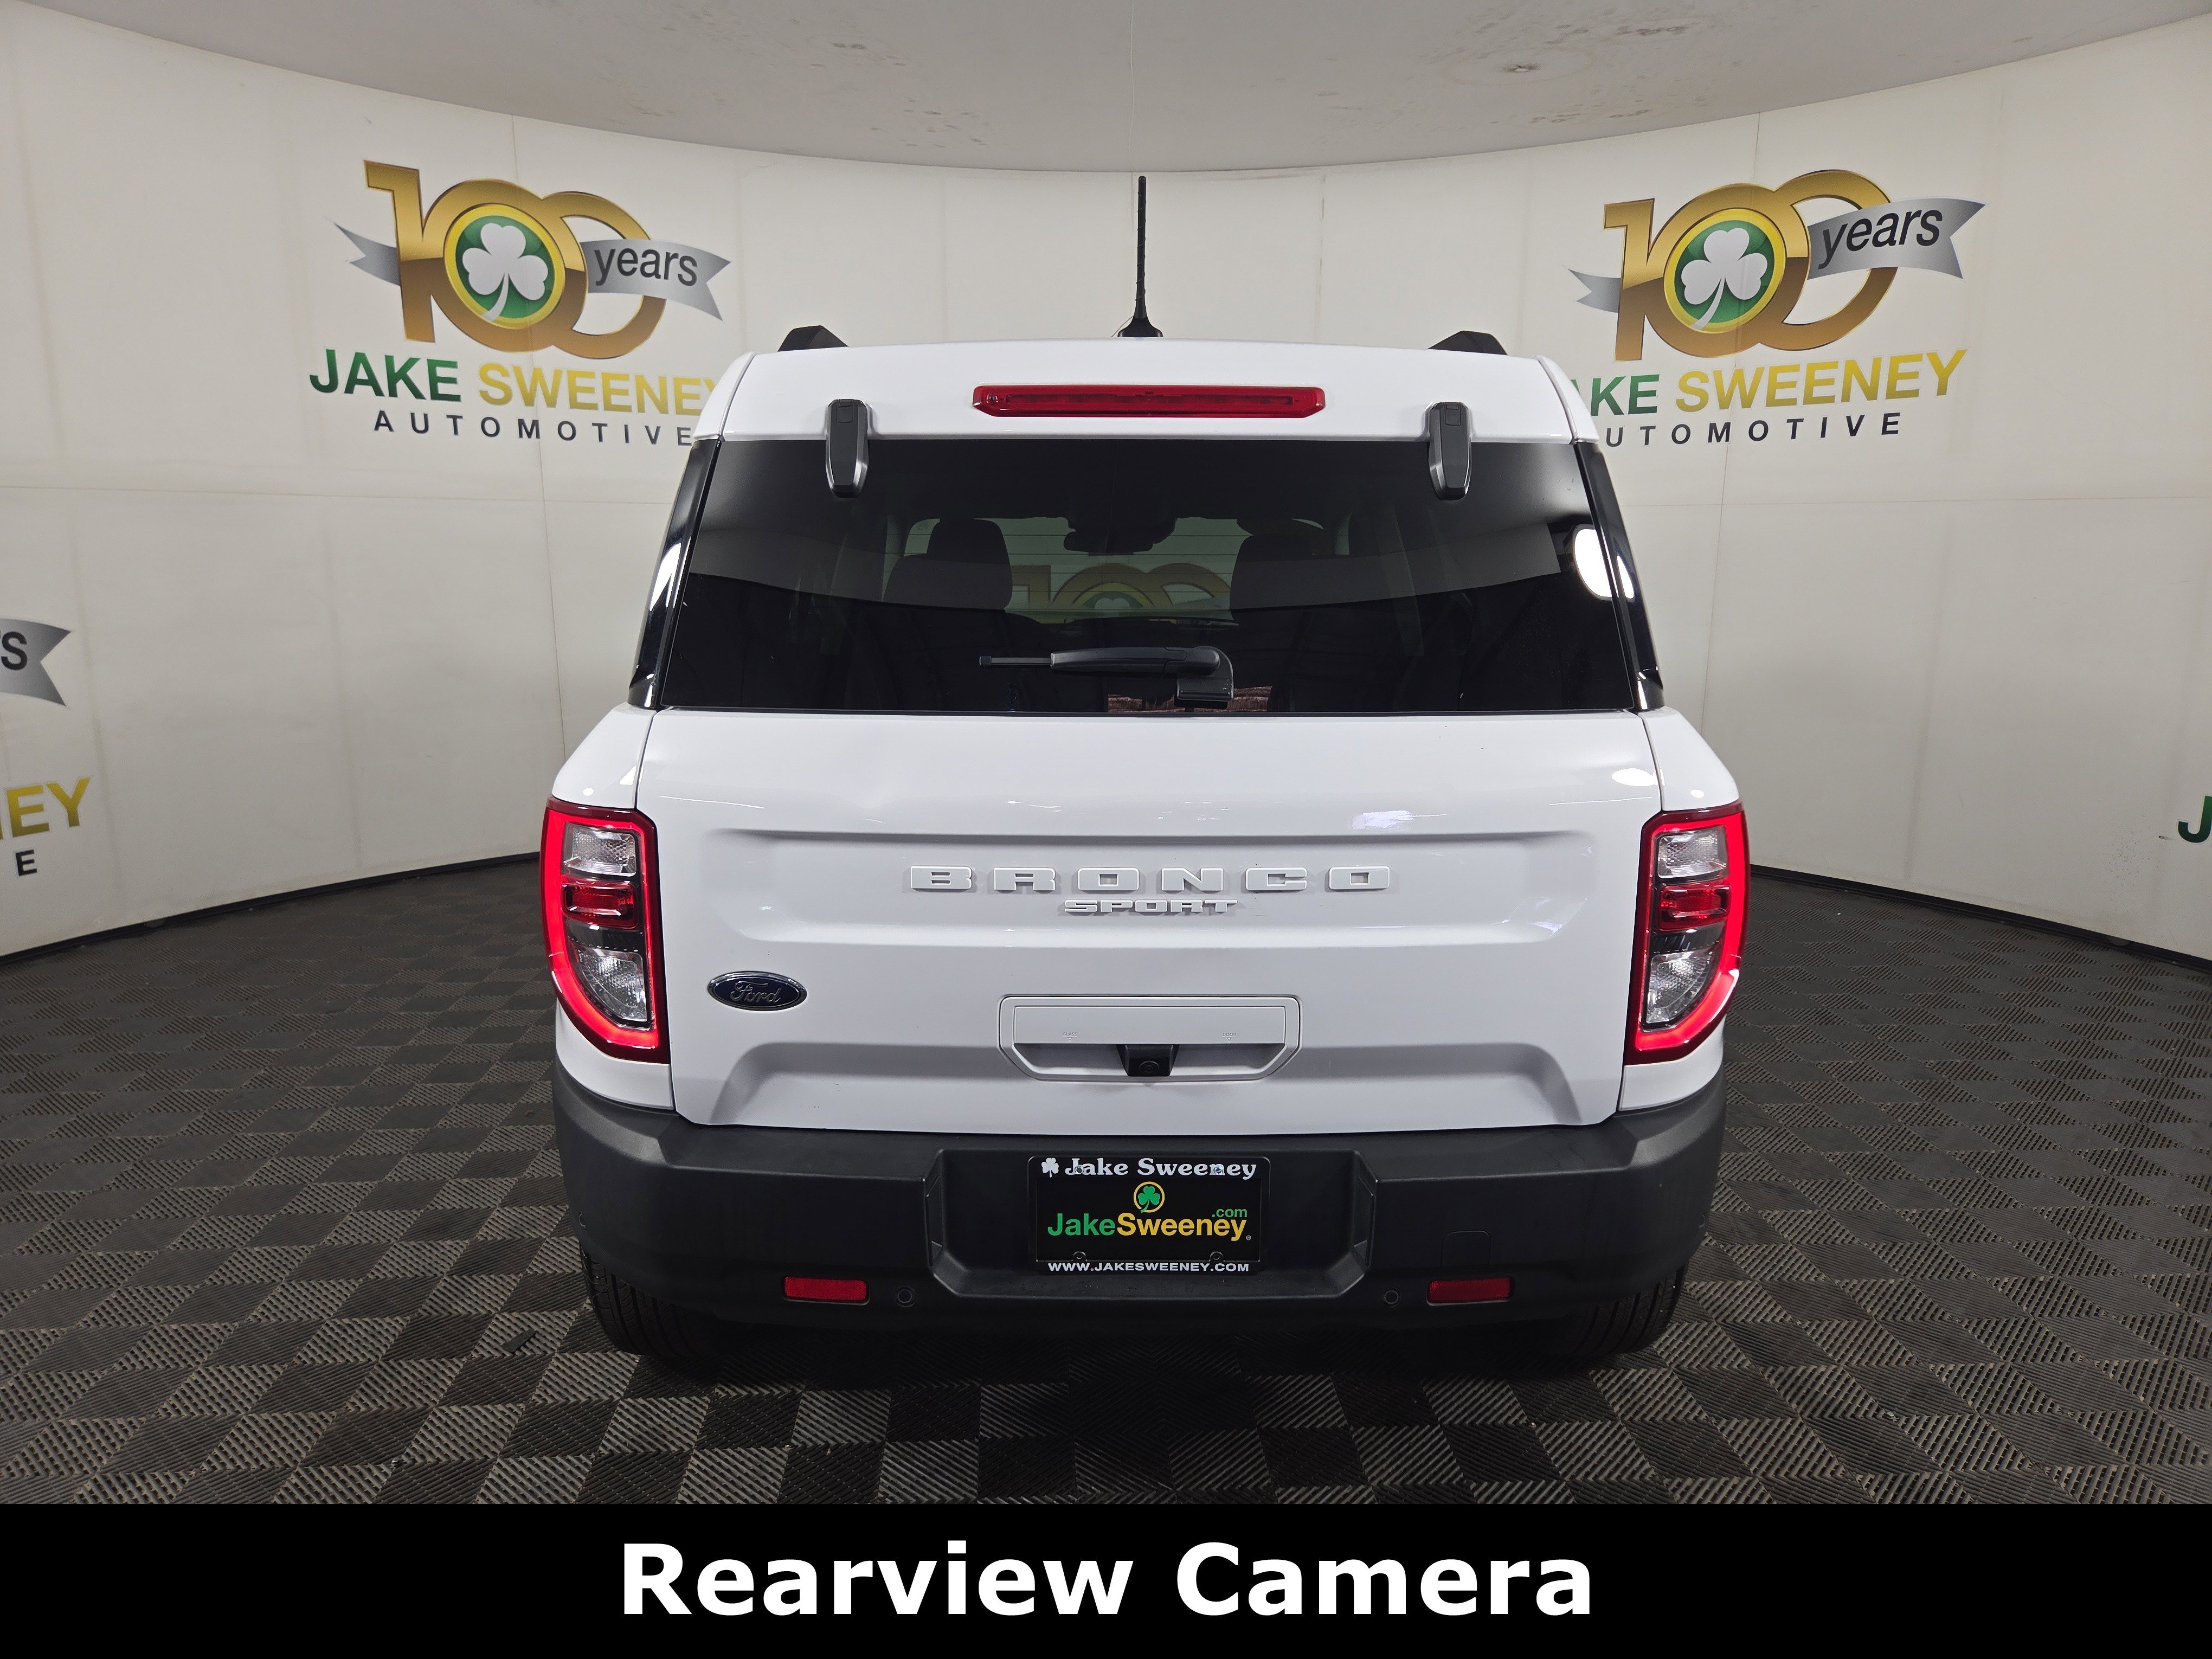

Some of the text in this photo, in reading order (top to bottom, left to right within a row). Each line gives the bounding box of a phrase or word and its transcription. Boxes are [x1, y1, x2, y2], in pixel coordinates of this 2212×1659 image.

[364, 160, 698, 359] 100 years
[1603, 169, 1943, 362] 100 years
[310, 348, 461, 402] JAKE
[1571, 348, 1969, 416] KE SWEENEY
[374, 410, 692, 446] AUTOMOTIVE
[1606, 412, 1900, 447] UTOMOTIVE
[911, 866, 1391, 891] BRONCO
[1064, 899, 1237, 914] SPORT
[730, 981, 781, 1002] Ford
[1065, 1158, 1257, 1180] Jake Sweeney
[1047, 1213, 1247, 1241] JakeSweeney
[1212, 1208, 1248, 1218] .com
[1047, 1263, 1249, 1271] WWW.JAKESWEENEY.COM
